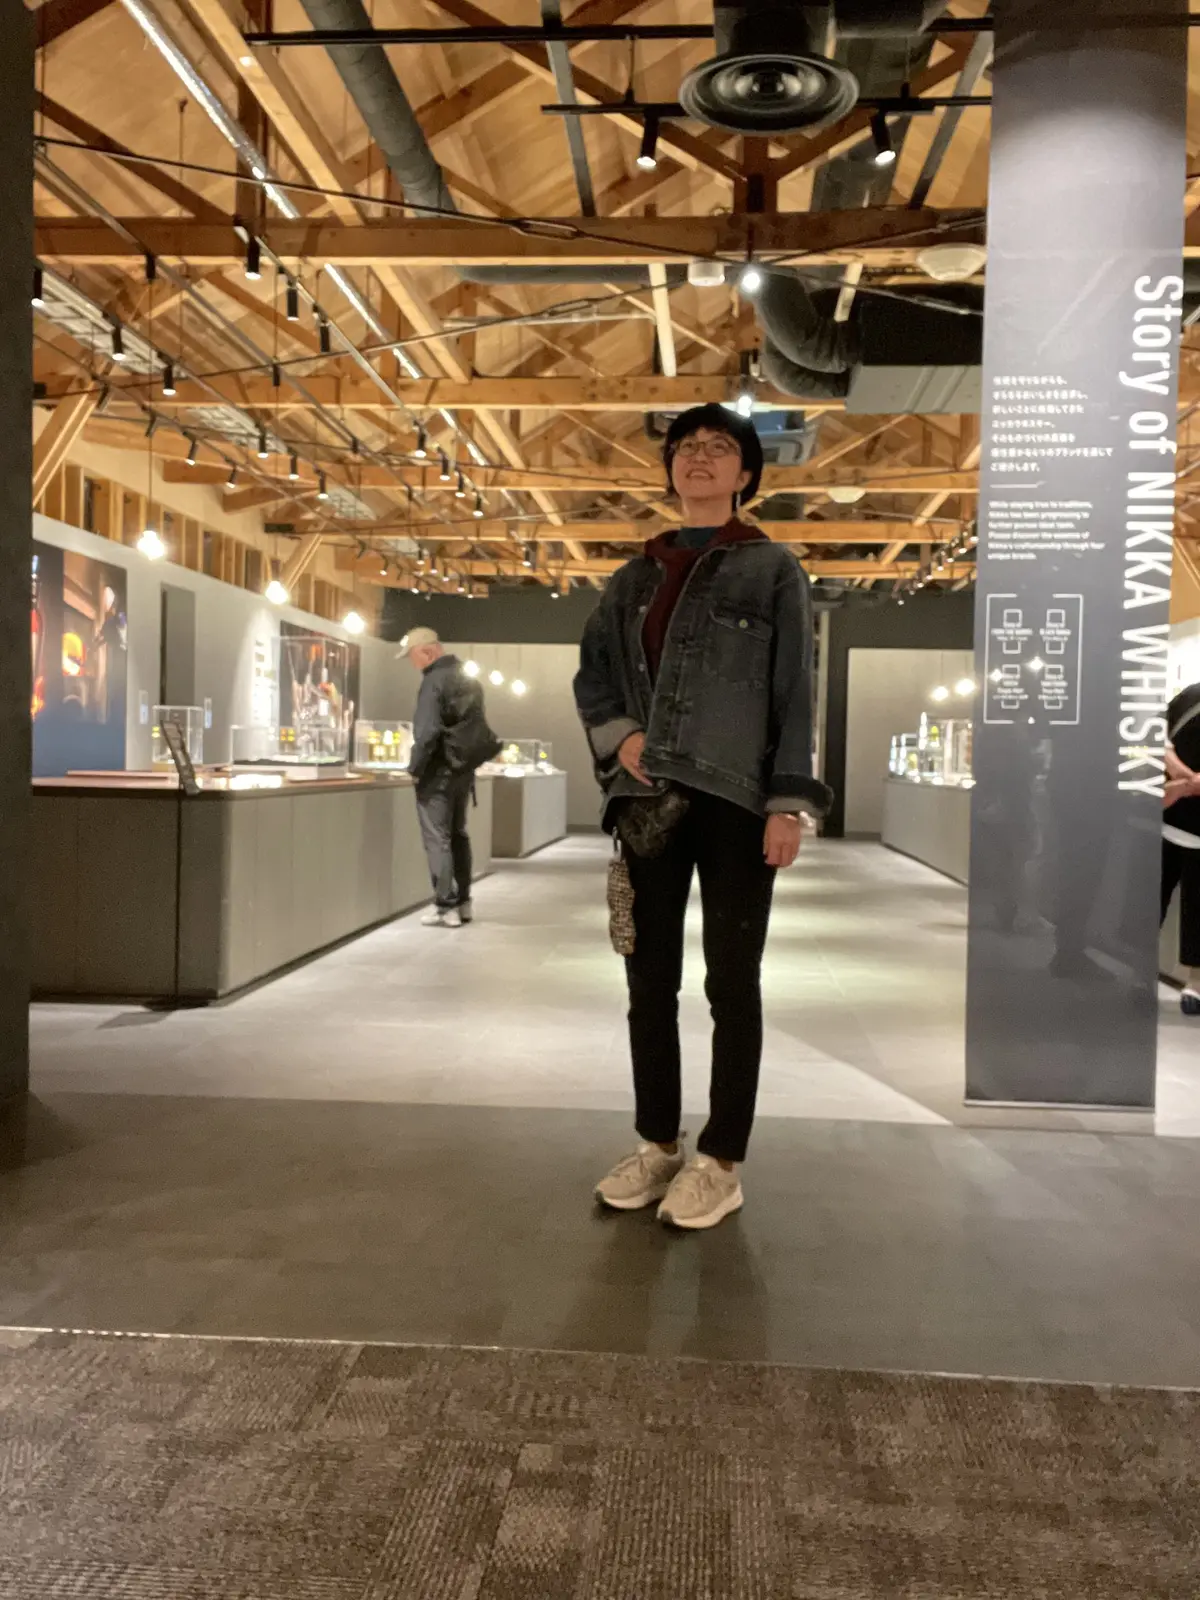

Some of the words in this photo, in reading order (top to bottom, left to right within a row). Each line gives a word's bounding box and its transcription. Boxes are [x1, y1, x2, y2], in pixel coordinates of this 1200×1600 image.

[1118, 275, 1184, 395] Story
[1128, 410, 1178, 455] of
[1122, 472, 1176, 609] NIKKA
[1117, 623, 1171, 798] WHISKY
